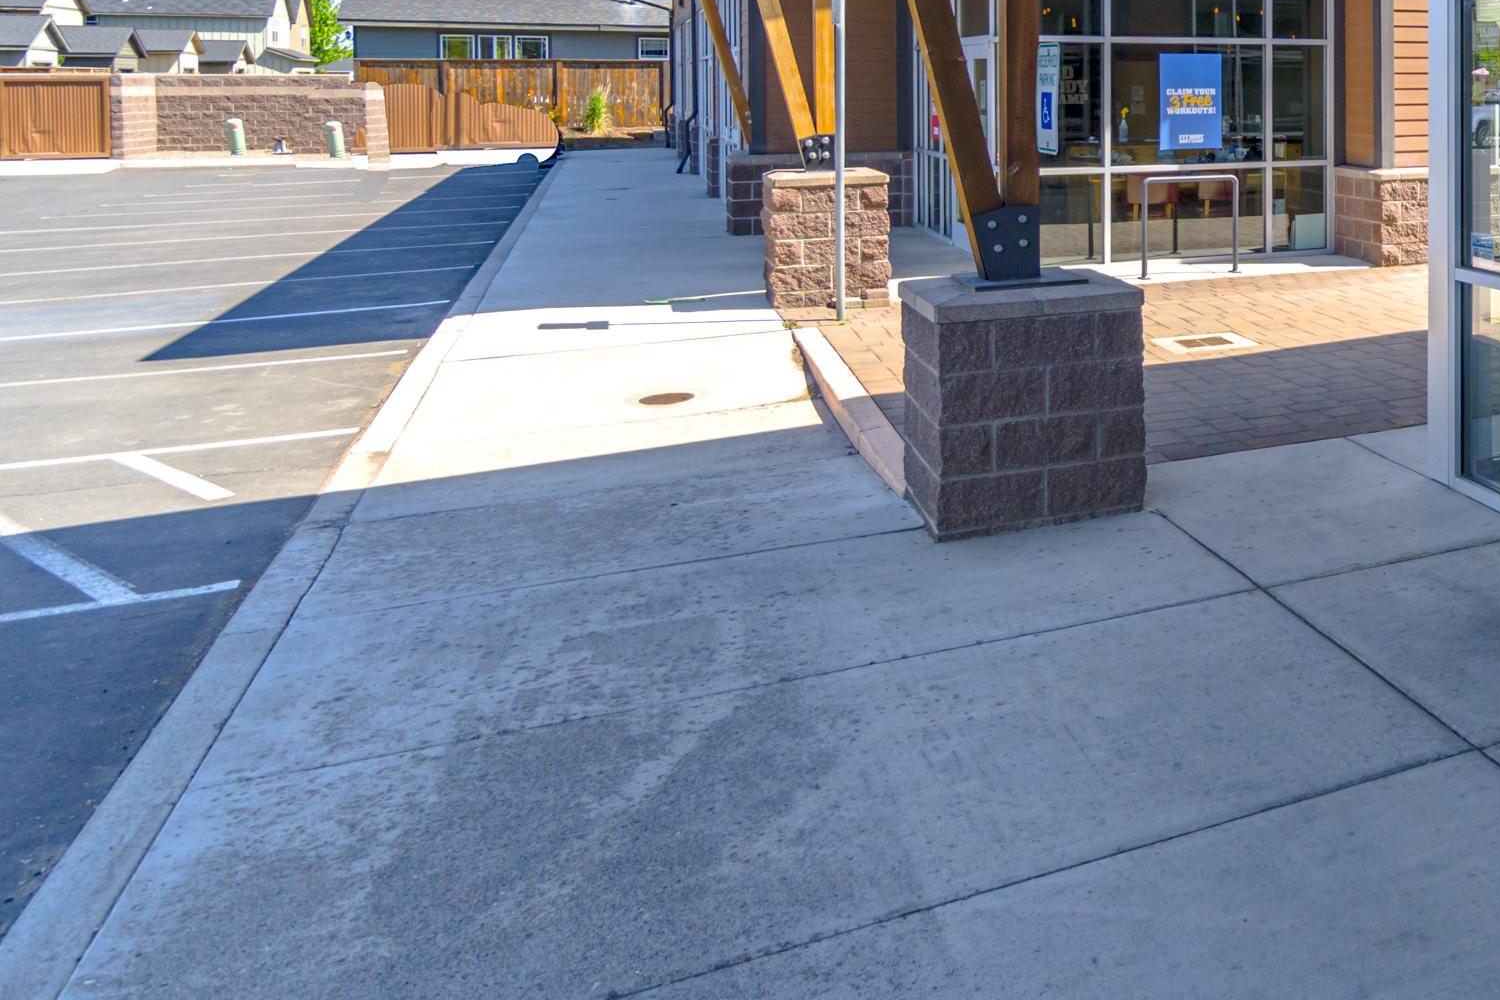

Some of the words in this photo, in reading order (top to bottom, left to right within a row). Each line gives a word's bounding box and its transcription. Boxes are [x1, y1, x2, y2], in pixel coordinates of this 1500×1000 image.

[1166, 88, 1193, 96] CLAIM
[1194, 88, 1216, 96] YOUR
[1169, 96, 1180, 109] 3
[1181, 93, 1213, 107] Free
[1166, 106, 1216, 115] WORKOUTS!
